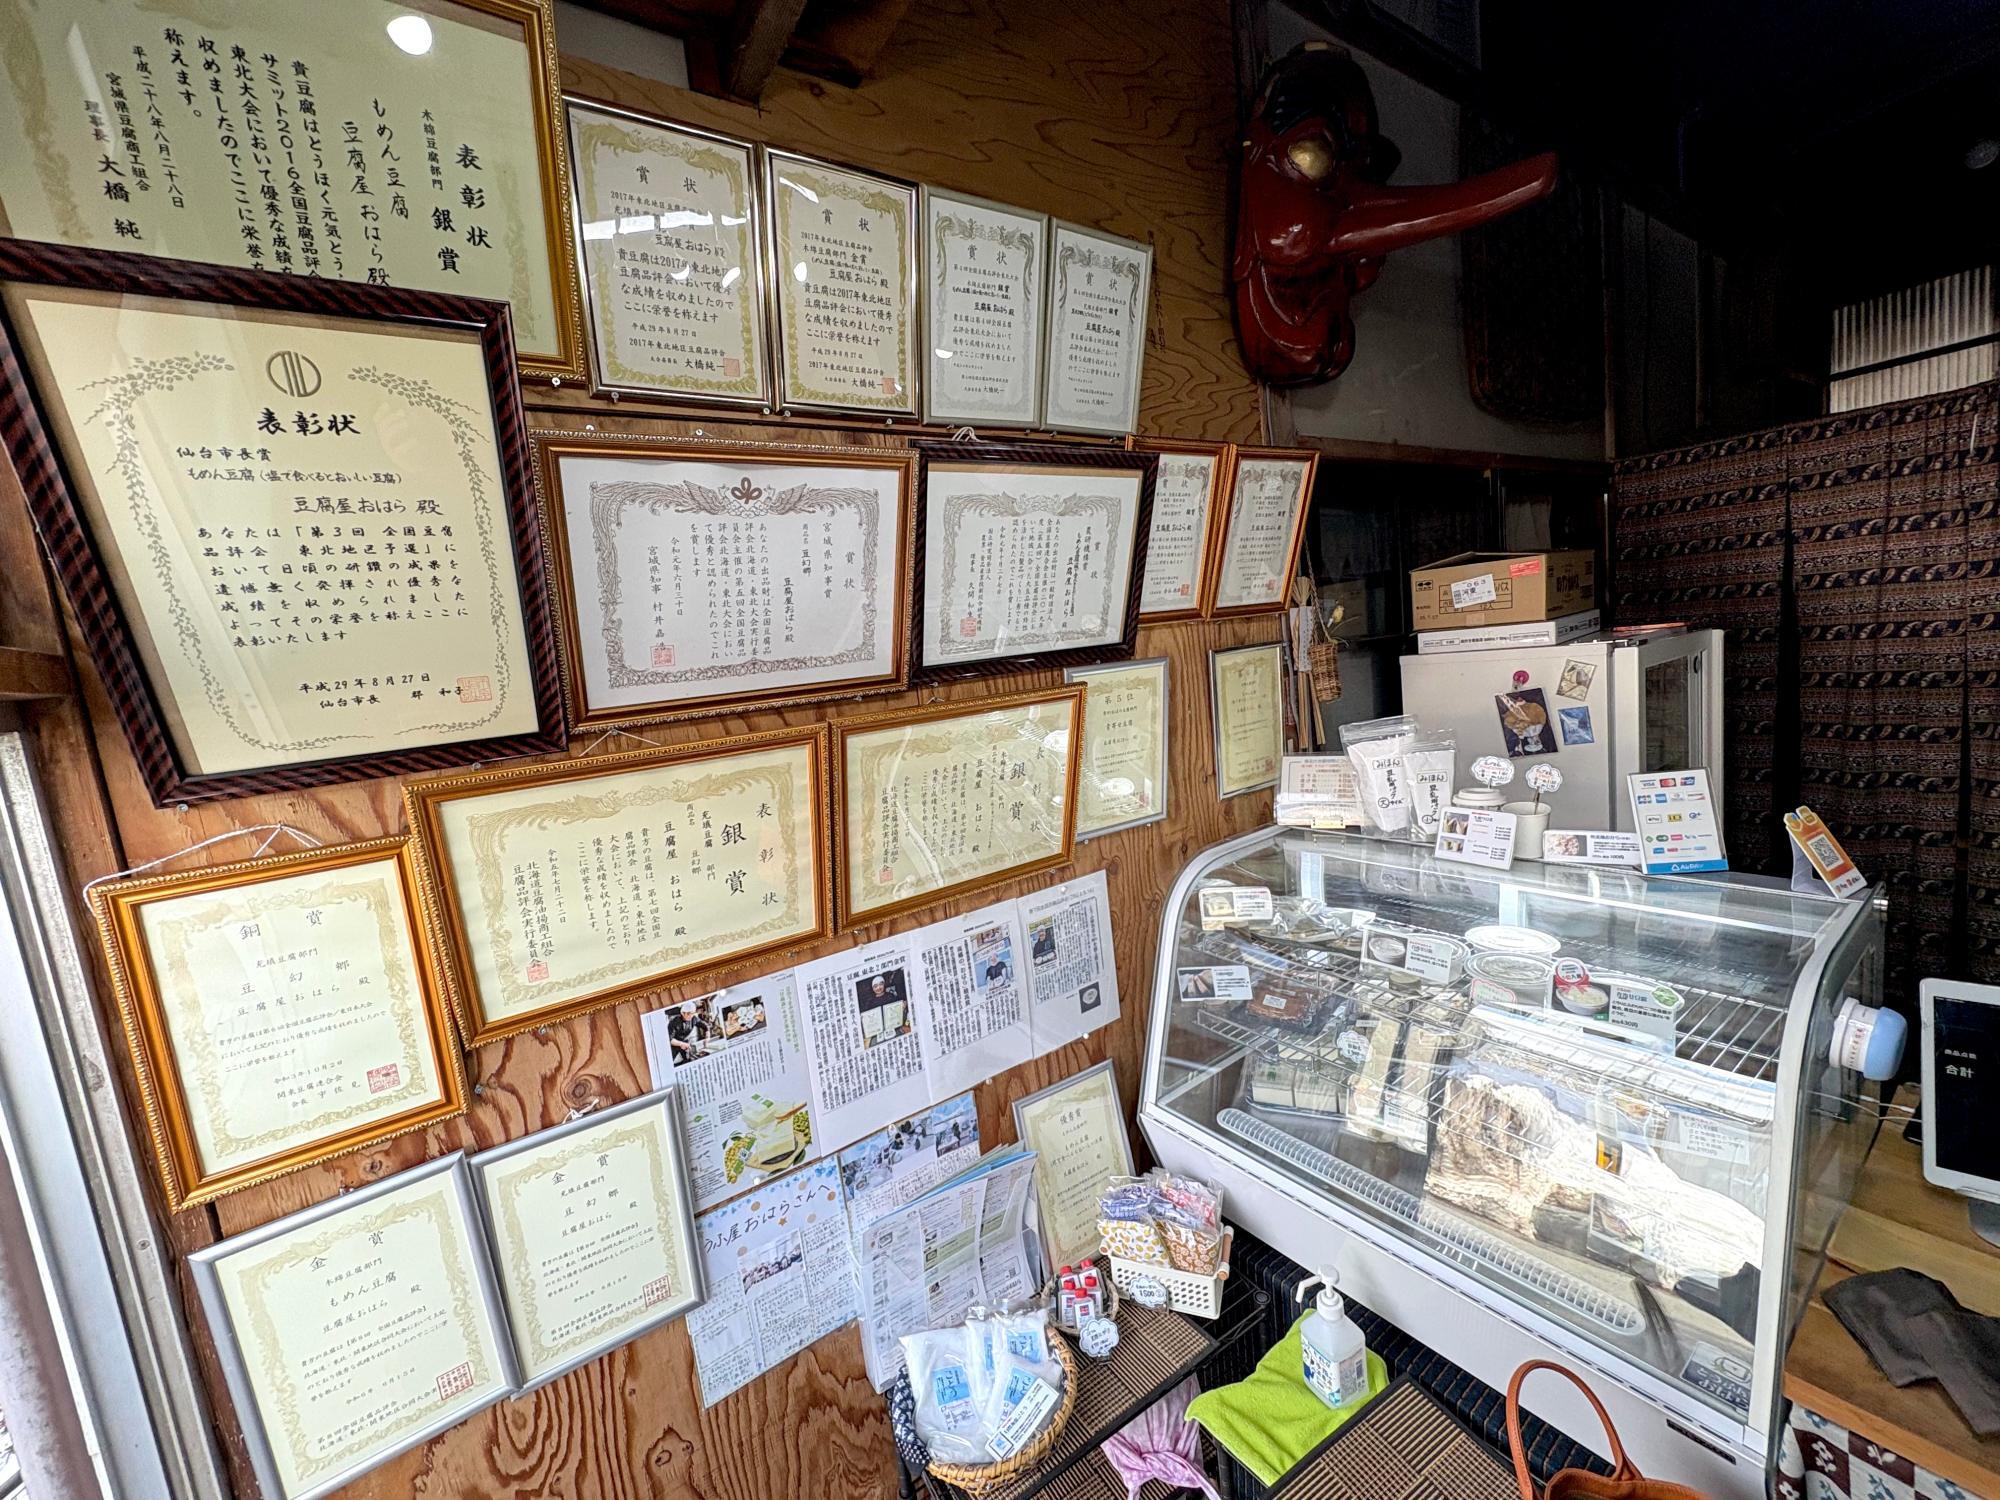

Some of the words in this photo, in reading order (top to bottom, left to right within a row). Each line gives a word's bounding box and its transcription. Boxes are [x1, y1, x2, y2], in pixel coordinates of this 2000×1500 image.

[164, 27, 203, 118] 称えます。
[105, 71, 151, 192] 宮城県豆腐商工組合
[132, 45, 185, 209] 平成二十八年八月二十八日
[372, 98, 409, 220] もめん豆腐
[421, 109, 444, 191] 木綿豆腐部門
[98, 153, 131, 203] 大橋
[291, 60, 345, 278] 貴豆腐はとうほく元気とう
[636, 165, 699, 194] 賞状
[456, 143, 493, 249] 表彰状
[114, 217, 143, 241] 純
[822, 208, 871, 233] 賞状
[431, 206, 461, 274] 銀賞
[655, 234, 713, 256] 豆腐屋おはら
[257, 406, 362, 436] 表彰状
[176, 446, 272, 462] 仙台市長賞
[293, 496, 407, 515] 豆腐屋おはら
[415, 498, 445, 516] 殿
[382, 524, 453, 538] 全国豆腐
[202, 545, 268, 558] 品評会
[299, 543, 457, 556] 東北地区予選」に
[822, 522, 834, 599] 宮城県知事賞
[843, 551, 856, 589] 賞状
[220, 591, 466, 613] 成績を収められました
[230, 607, 469, 630] よってその栄誉を称えここに
[233, 630, 348, 649] 表彰いたします
[300, 672, 431, 693] 平成29年8月27日
[319, 695, 381, 709] 仙台市長
[1009, 762, 1026, 824] 銀賞
[663, 822, 679, 860] 豆腐屋
[755, 801, 779, 907] 表彰状
[720, 821, 748, 897] 銀賞
[669, 874, 684, 913] おはら
[240, 909, 324, 941] 銅賞
[673, 926, 688, 938] 殿
[237, 984, 341, 1017] 豆腐屋おはら
[1944, 1064, 1975, 1079] 合計
[551, 1153, 609, 1186] 金賞
[310, 1230, 385, 1272] 金賞
[330, 1271, 397, 1308] もめん豆腐
[322, 1300, 389, 1334] 豆腐屋おはら
